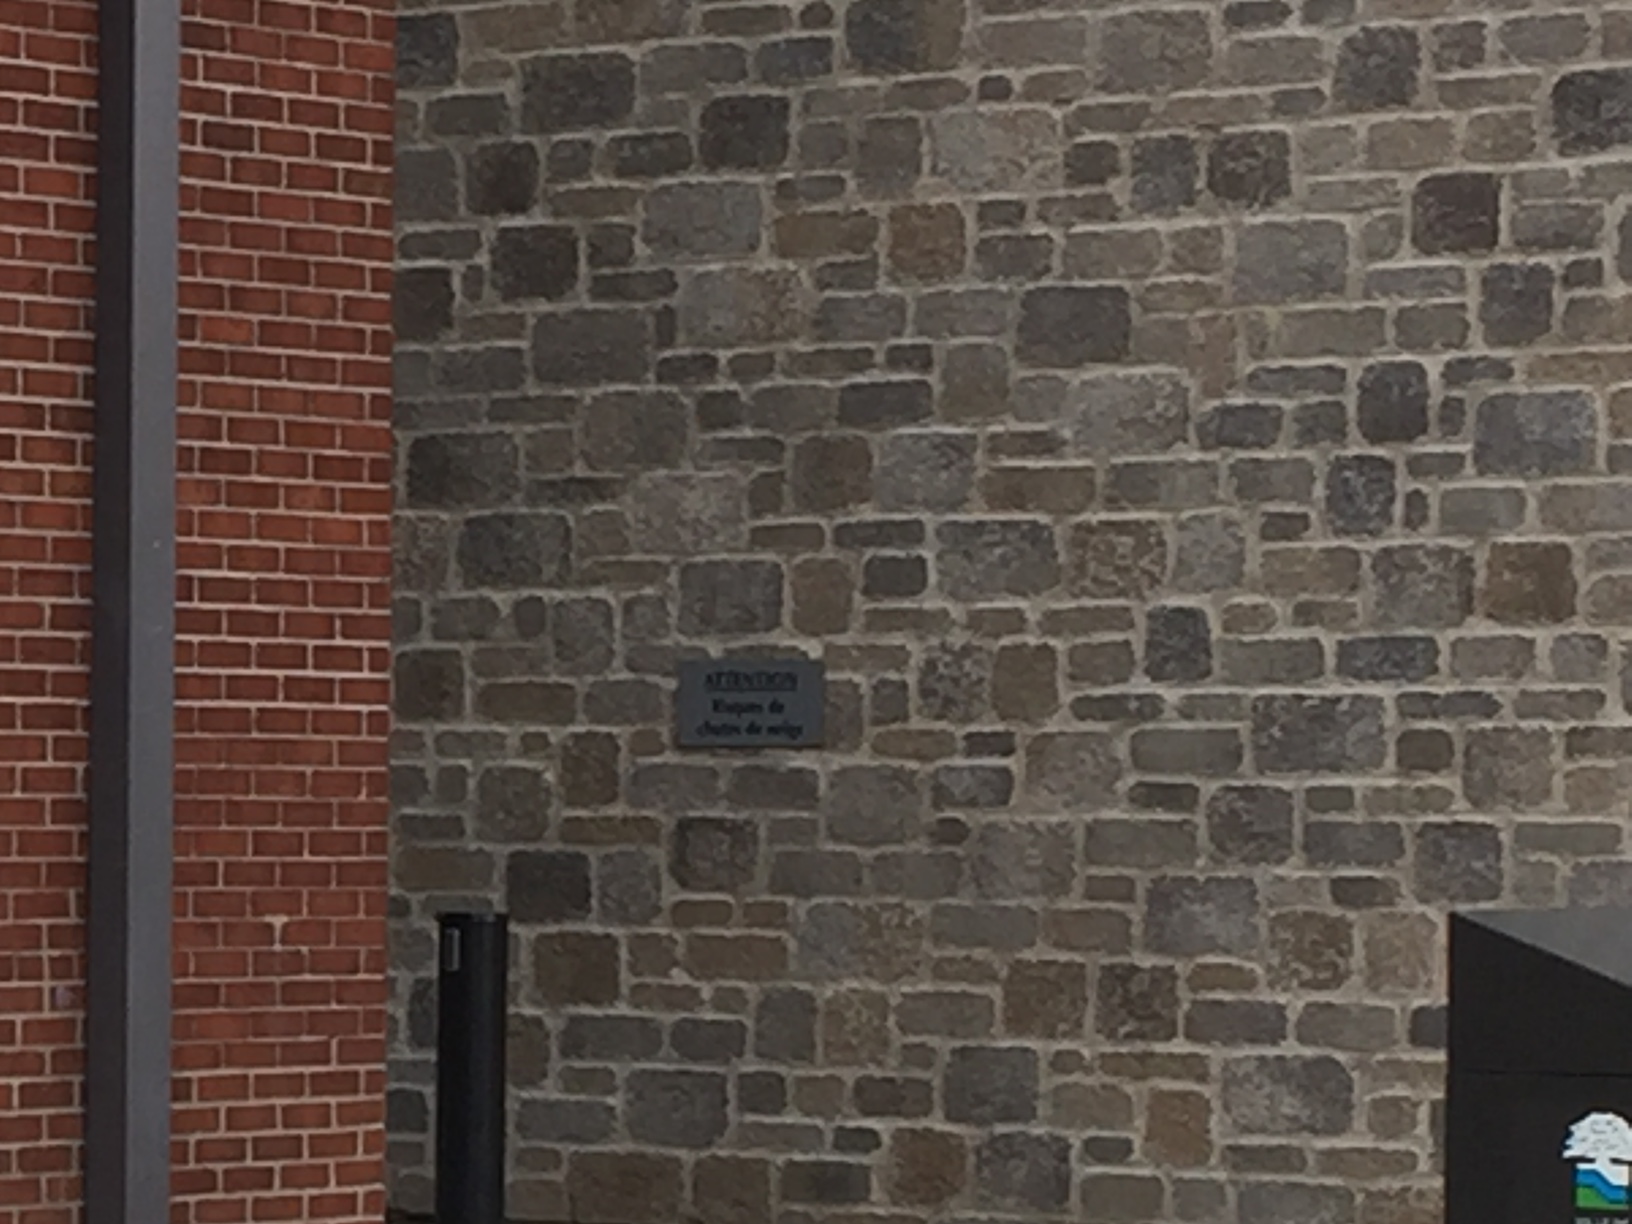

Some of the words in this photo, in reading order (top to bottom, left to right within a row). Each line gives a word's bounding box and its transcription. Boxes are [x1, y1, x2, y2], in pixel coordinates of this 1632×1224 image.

[704, 670, 798, 690] ATTENTION
[769, 697, 785, 714] de
[745, 720, 762, 735] de
